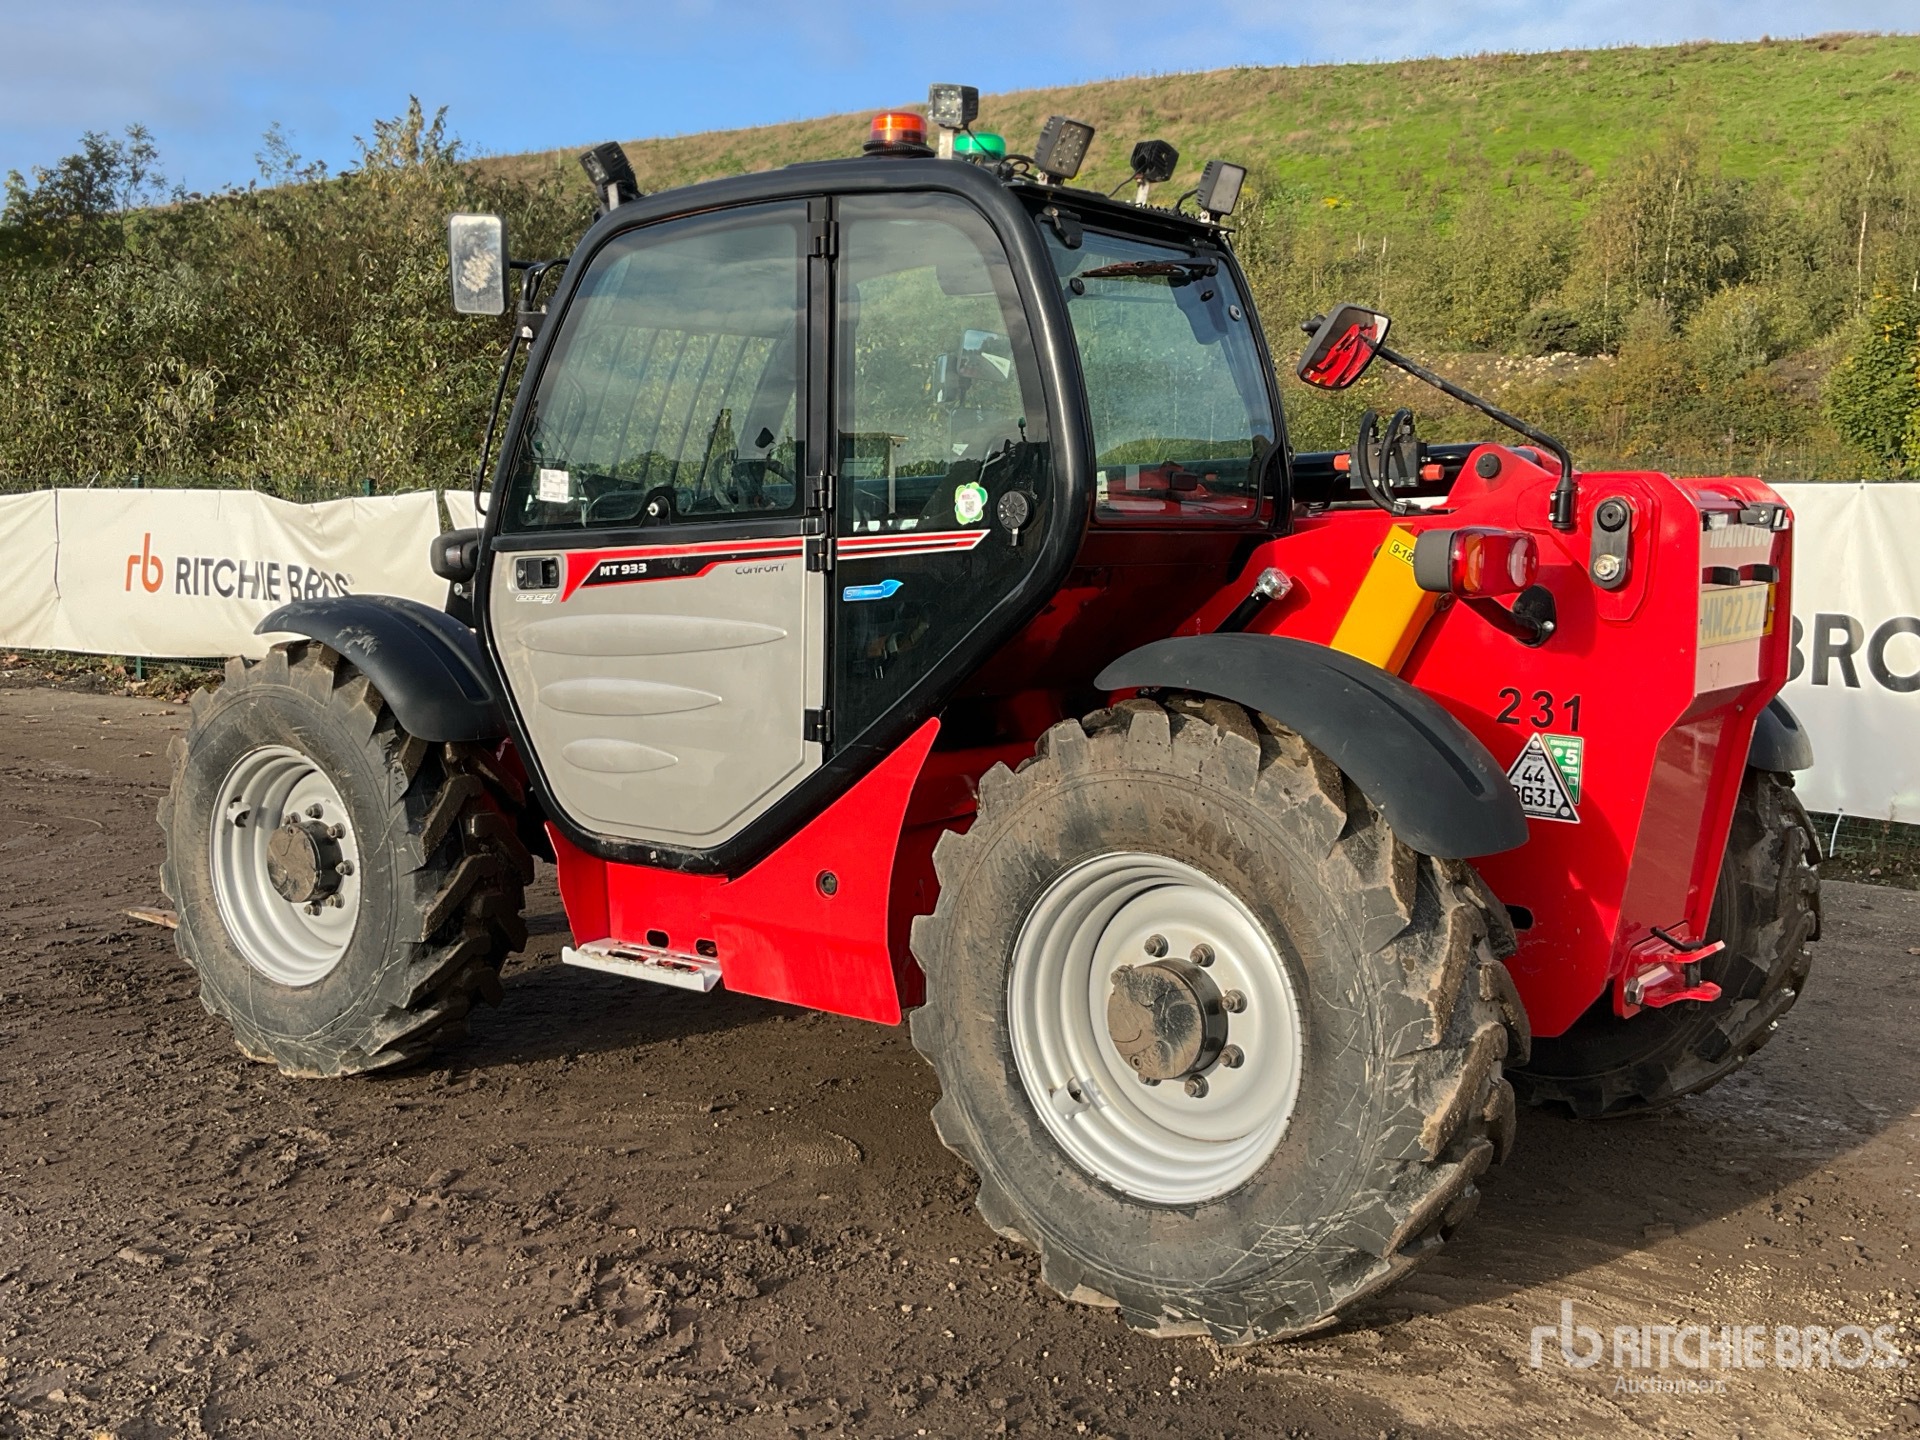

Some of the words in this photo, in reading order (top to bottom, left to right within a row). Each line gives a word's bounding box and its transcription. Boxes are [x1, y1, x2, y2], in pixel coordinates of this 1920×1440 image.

[1391, 543, 1415, 566] 9-18
[125, 533, 164, 593] rb
[175, 557, 281, 602] RITCHIE
[600, 565, 619, 577] MT
[621, 563, 647, 575] 933
[516, 593, 557, 604] easy
[1496, 687, 1581, 732] 231
[1564, 748, 1578, 765] 5
[1521, 765, 1546, 785] 44
